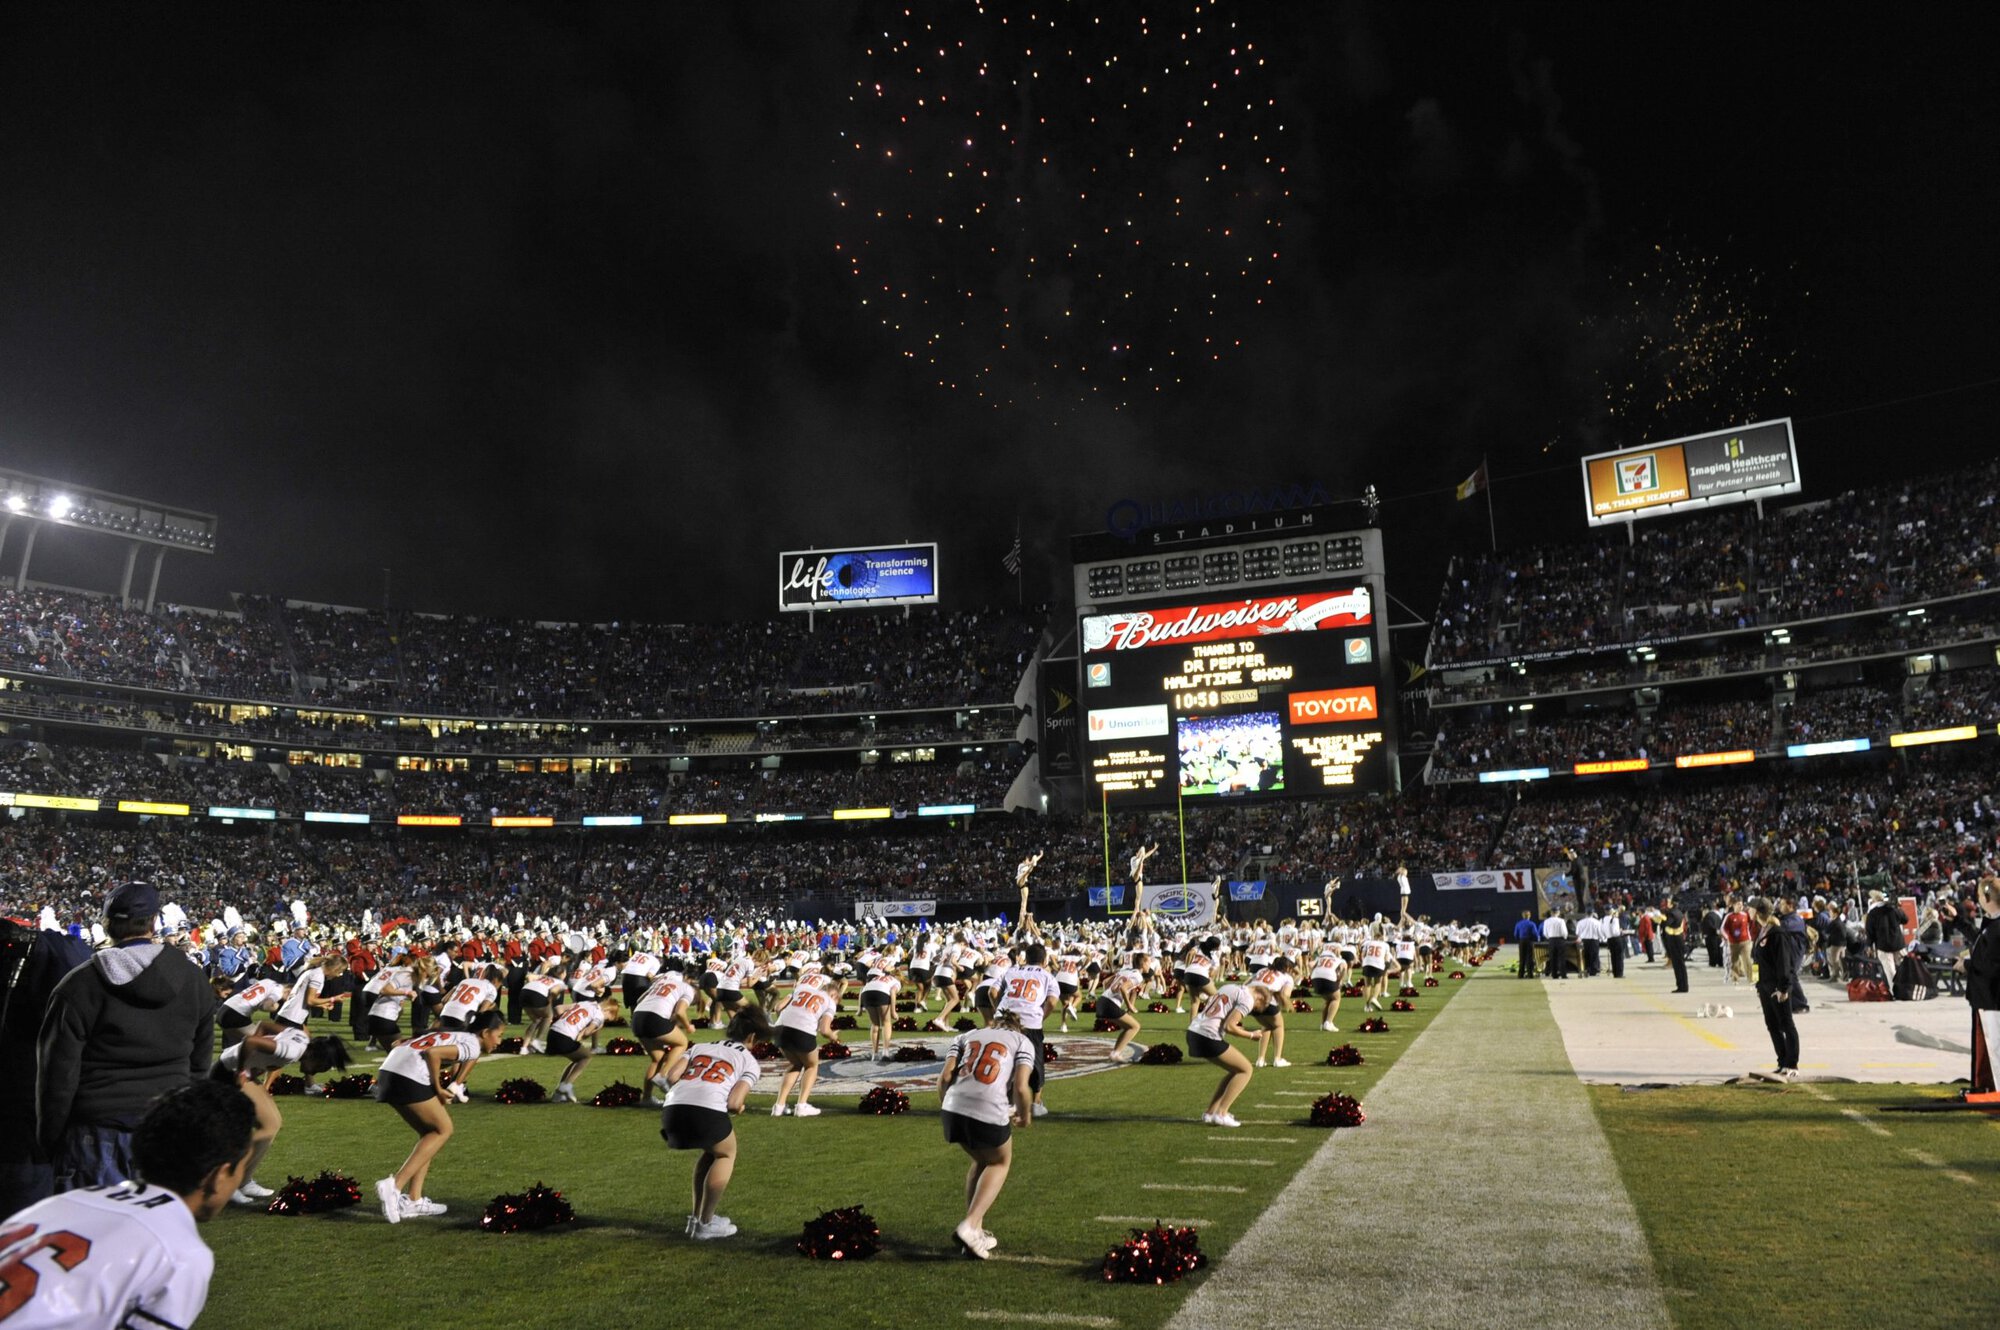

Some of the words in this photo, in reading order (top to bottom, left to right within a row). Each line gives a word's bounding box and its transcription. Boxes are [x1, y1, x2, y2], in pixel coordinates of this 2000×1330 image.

[1690, 462, 1731, 478] Imaging
[1732, 452, 1788, 468] Healthcare
[1697, 482, 1713, 492] Your
[1716, 477, 1743, 489] Partner
[1745, 475, 1753, 483] in
[1755, 471, 1780, 482] Health
[1612, 496, 1645, 509] THANK
[1153, 514, 1313, 543] STADIUM
[865, 558, 928, 569] Transforming
[879, 568, 914, 577] science
[784, 557, 834, 600] life
[1106, 598, 1297, 650] Budweiser
[1193, 643, 1235, 657] THANKS
[1239, 642, 1255, 653] TO
[1183, 659, 1204, 673] DR
[1209, 654, 1265, 670] PEPPER
[1164, 671, 1242, 690] HALFTIME
[1251, 666, 1293, 682] SHOW
[1293, 696, 1373, 716] TOYOTA
[1047, 716, 1076, 729] Sprint
[1503, 872, 1525, 890] N
[1159, 890, 1183, 900] PACIFIC
[862, 904, 877, 919] A
[1301, 902, 1320, 915] 25
[1368, 945, 1382, 957] 36
[1007, 978, 1041, 1002] 36
[792, 991, 825, 1013] 36
[680, 1055, 734, 1084] 36
